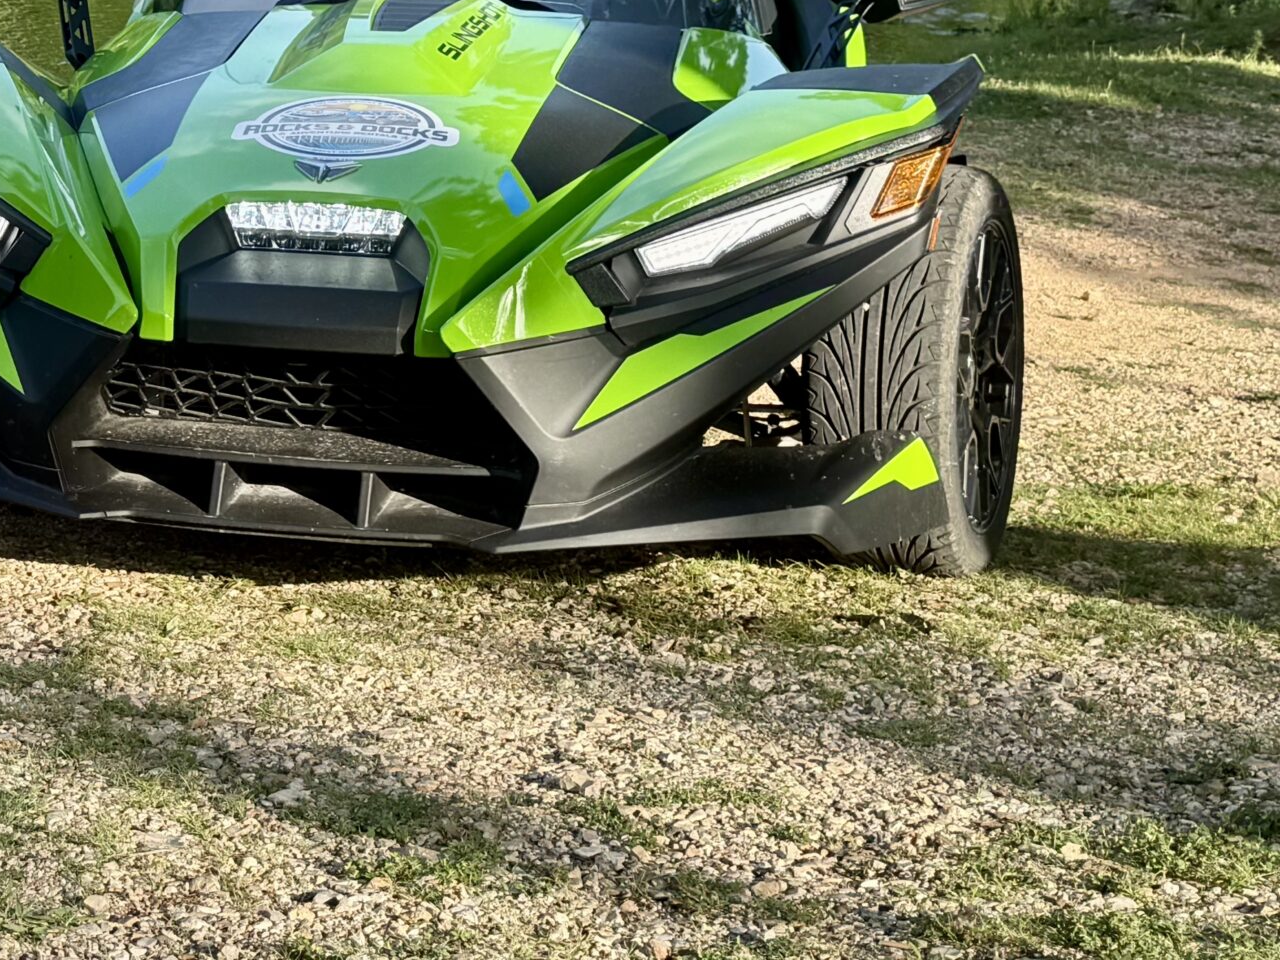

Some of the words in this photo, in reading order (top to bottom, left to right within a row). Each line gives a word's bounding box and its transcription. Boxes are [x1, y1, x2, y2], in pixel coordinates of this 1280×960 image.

[437, 1, 506, 61] SLINGSHOT
[242, 123, 330, 136] ROCKS
[360, 124, 449, 142] DOCKS
